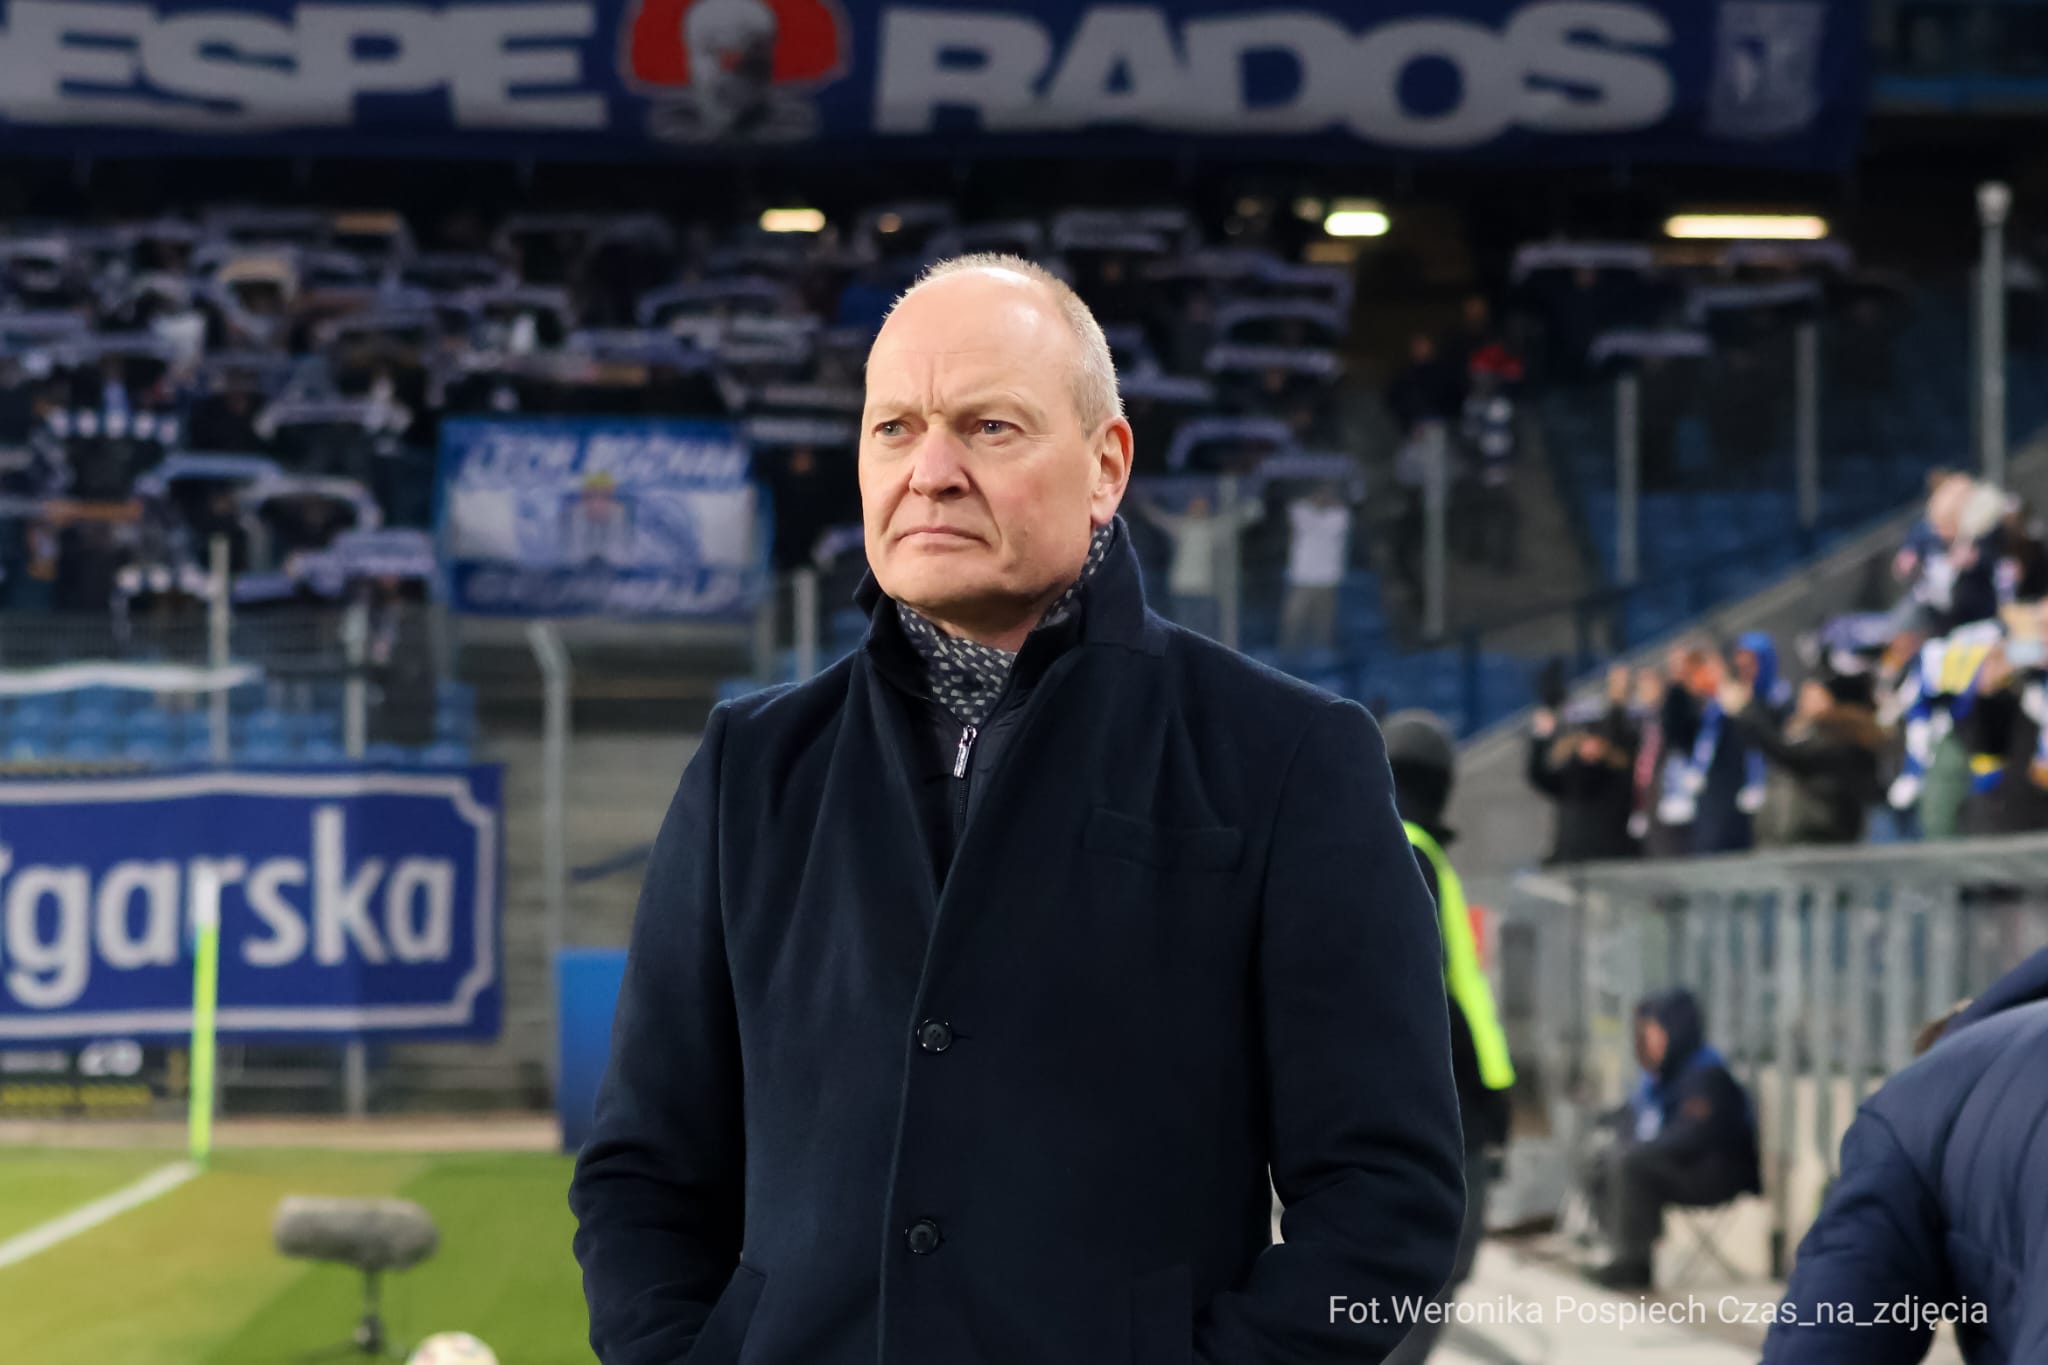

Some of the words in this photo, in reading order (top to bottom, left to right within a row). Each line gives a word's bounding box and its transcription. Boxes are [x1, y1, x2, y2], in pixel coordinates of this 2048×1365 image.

[0, 2, 607, 131] ESPE
[874, 1, 1673, 147] RADOS
[0, 807, 456, 1008] garska
